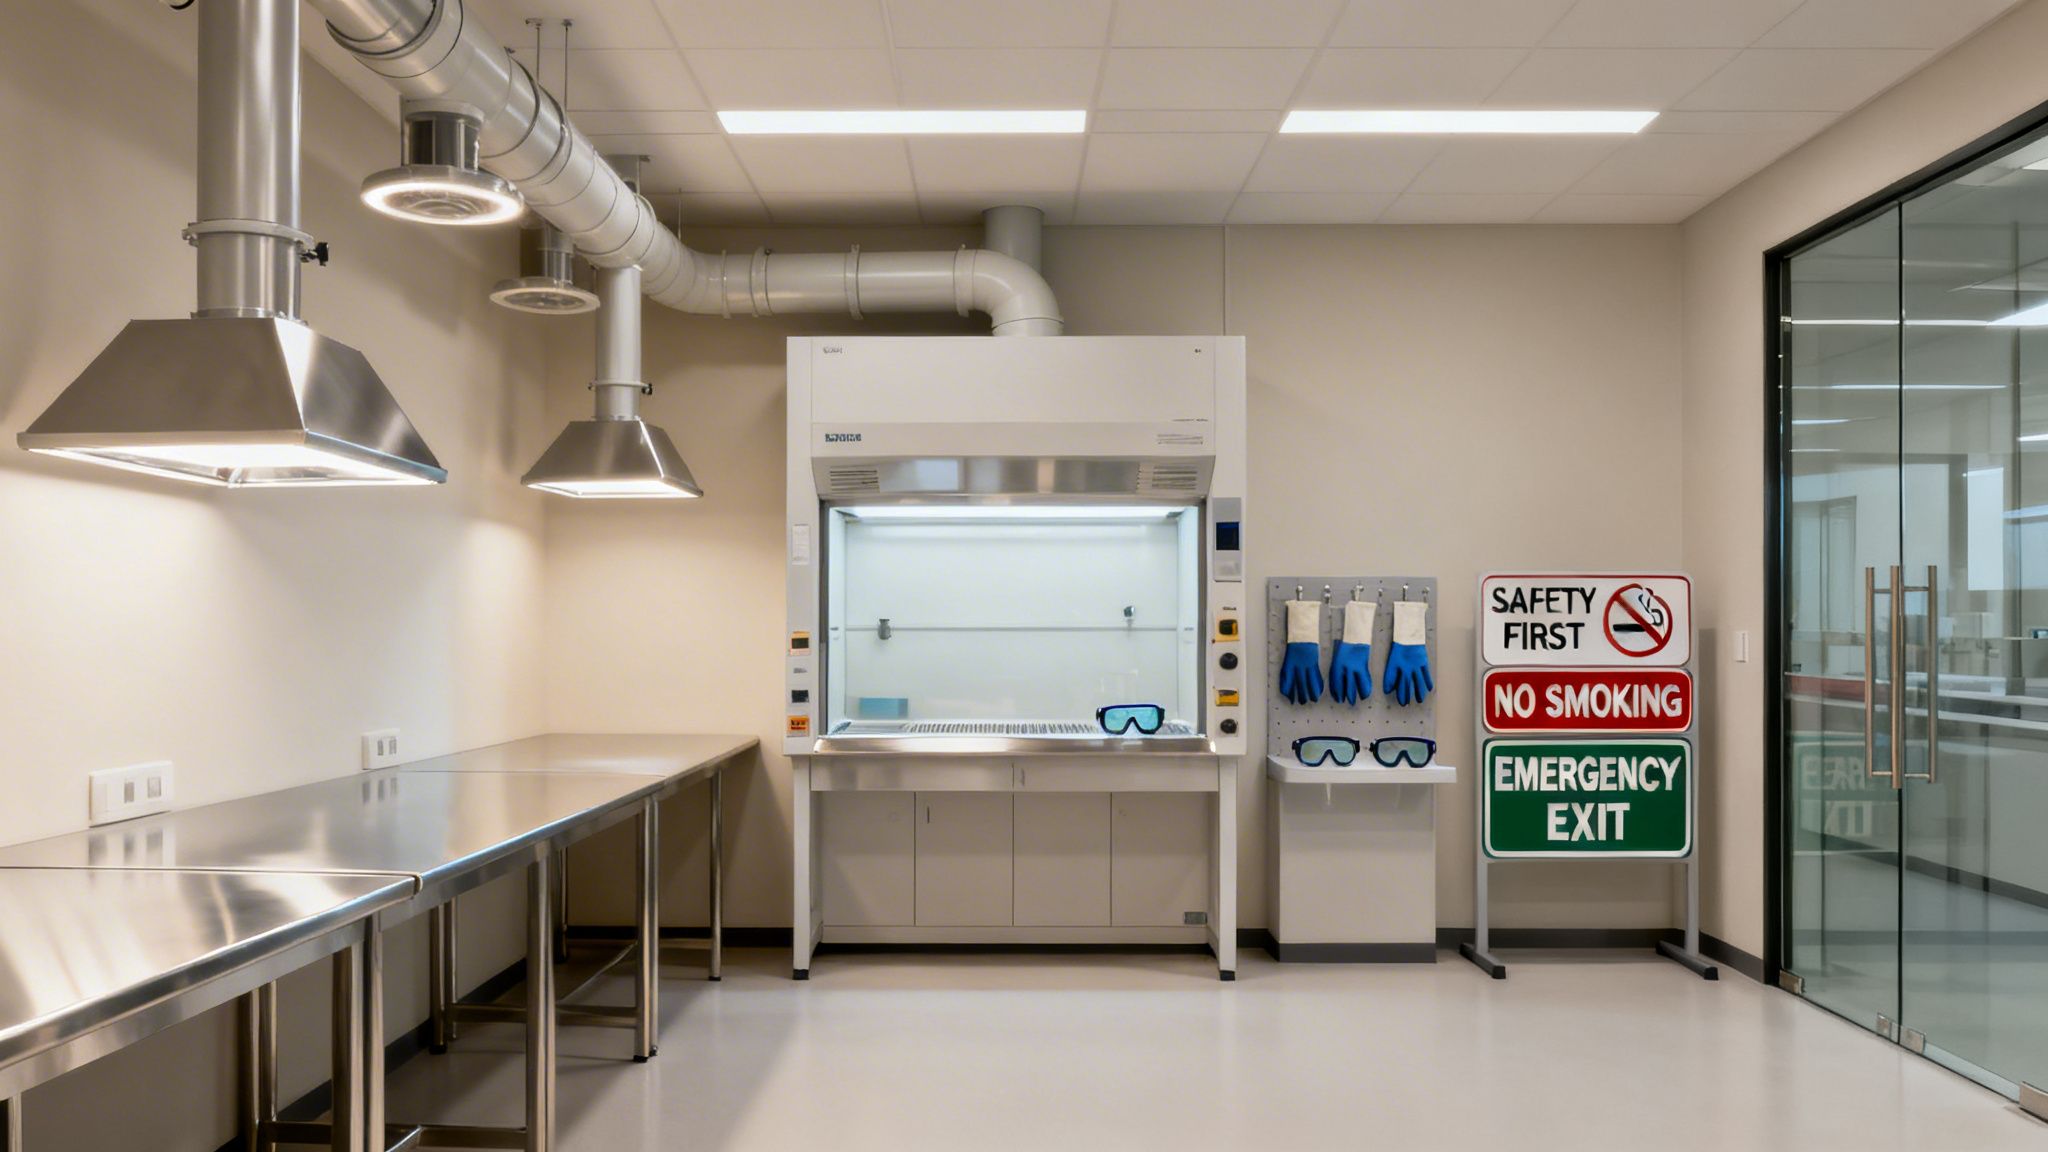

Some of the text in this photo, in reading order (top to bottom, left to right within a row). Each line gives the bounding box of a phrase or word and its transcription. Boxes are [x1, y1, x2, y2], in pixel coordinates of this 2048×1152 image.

[1492, 587, 1597, 614] SAFETY
[1504, 622, 1585, 650] FIRST
[1495, 683, 1683, 718] NO SMOKING
[1495, 755, 1682, 792] EMERGENCY
[1547, 802, 1631, 841] EXIT
